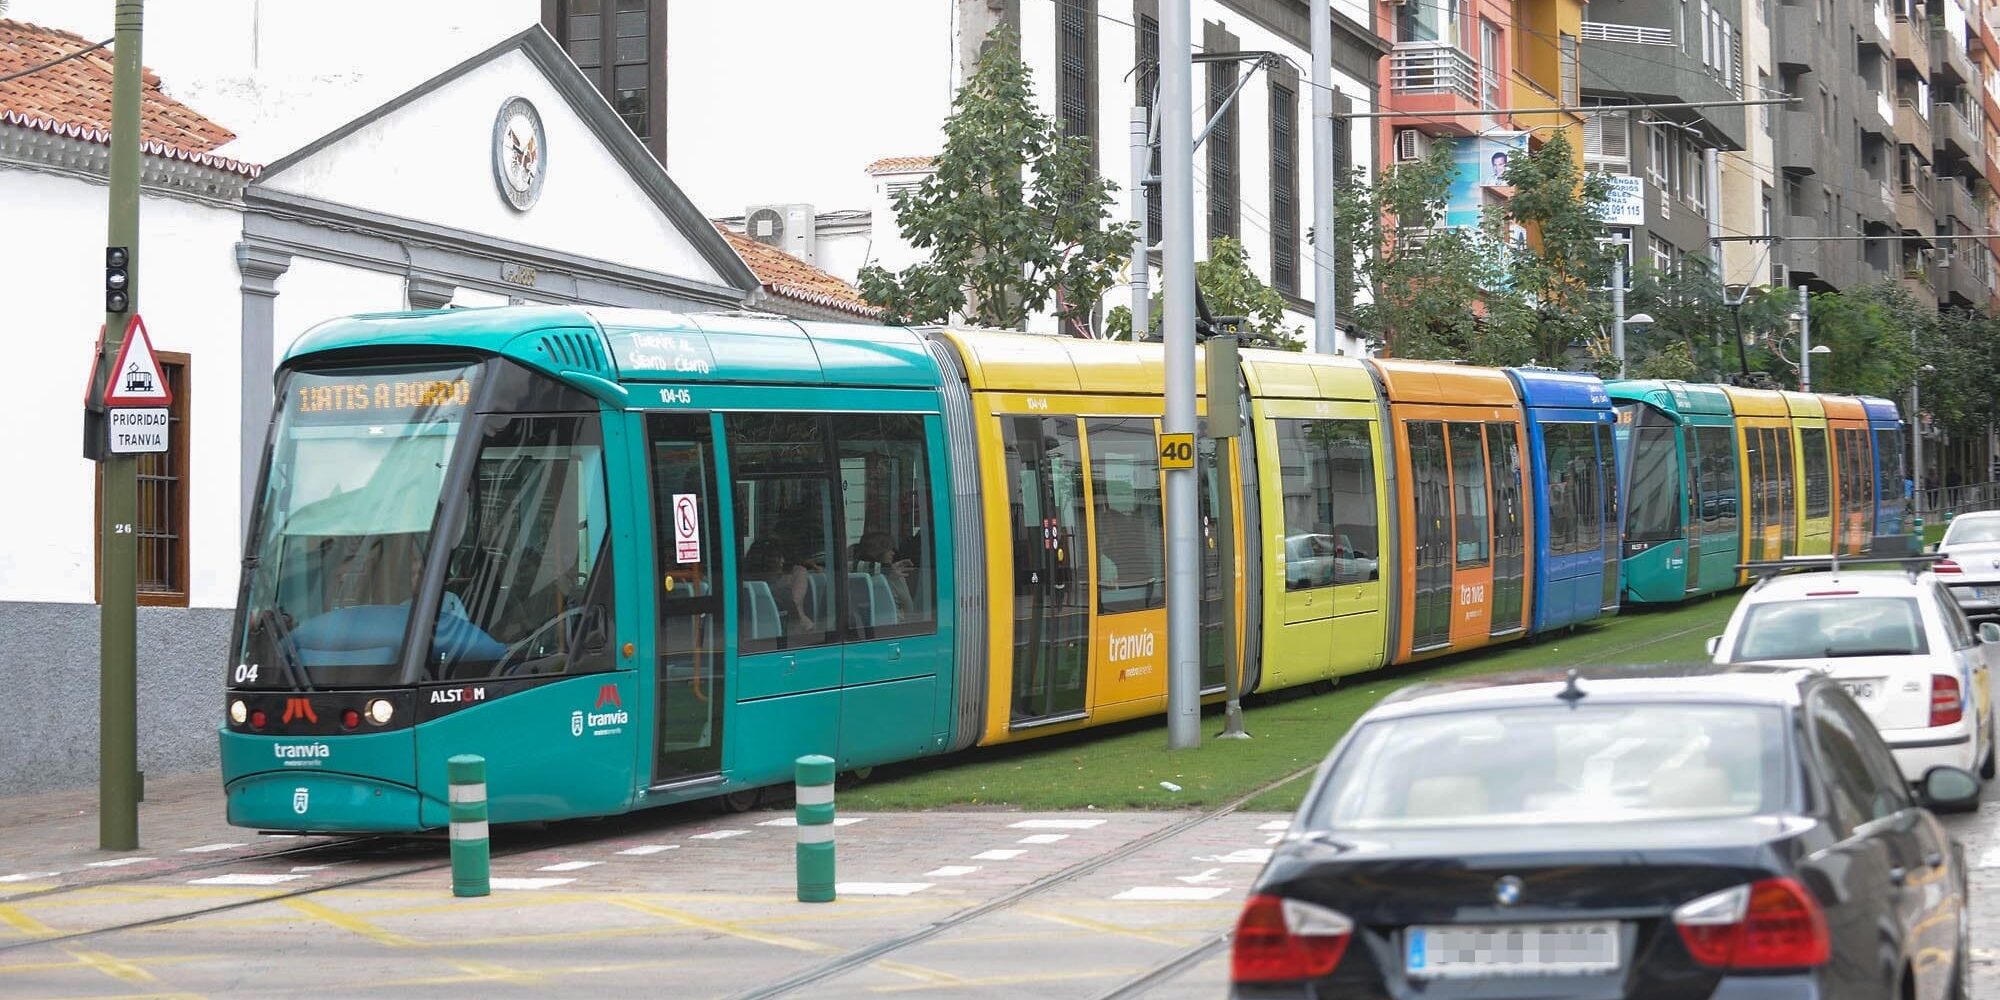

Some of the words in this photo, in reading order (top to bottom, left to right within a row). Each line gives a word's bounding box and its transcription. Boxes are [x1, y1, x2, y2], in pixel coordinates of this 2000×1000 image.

[1626, 205, 1641, 216] 115
[374, 382, 390, 409] A
[394, 379, 472, 408] BORDO
[659, 388, 692, 404] 104-05
[112, 413, 167, 426] PRIORIDAD
[118, 433, 161, 446] TRANVIA
[1162, 441, 1193, 461] 40
[114, 523, 132, 535] 26
[234, 663, 259, 683] 04
[430, 687, 486, 704] ALSTOM
